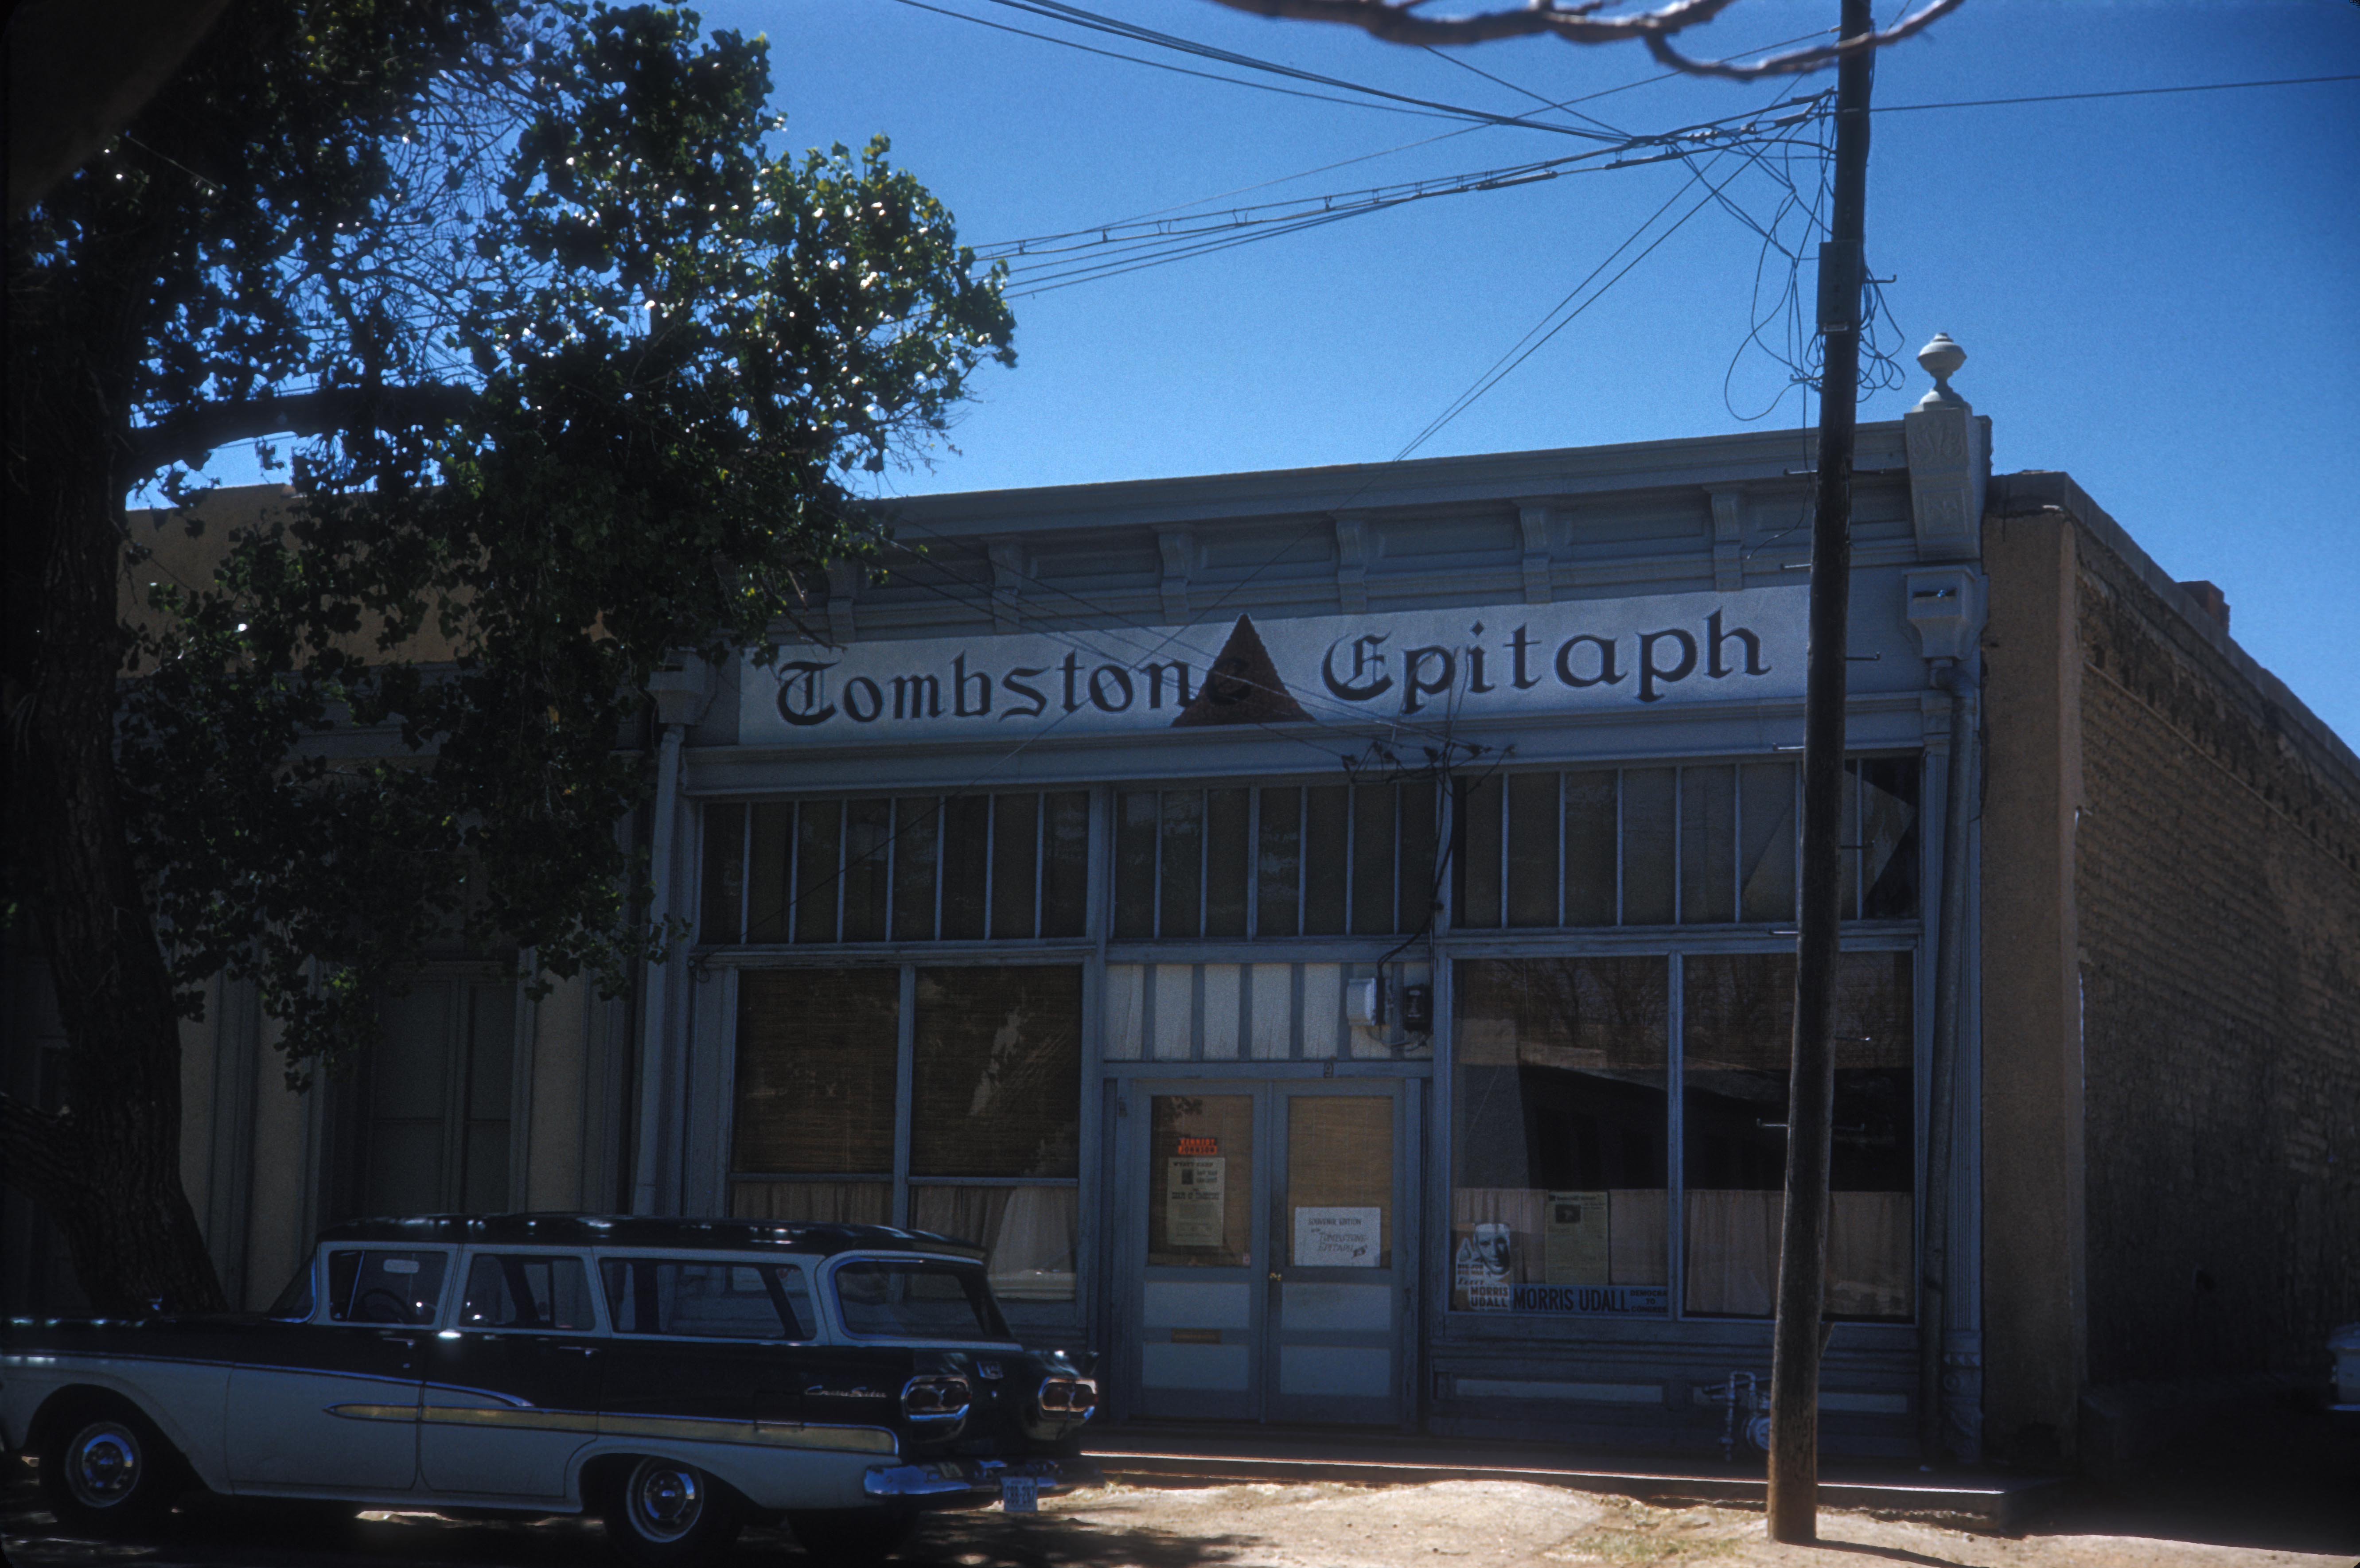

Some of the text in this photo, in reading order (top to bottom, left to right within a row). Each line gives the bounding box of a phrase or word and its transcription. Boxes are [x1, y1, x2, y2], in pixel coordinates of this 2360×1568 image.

[776, 605, 1772, 726] Tombstone Epitaph
[1471, 1287, 1508, 1296] MORRIS
[1513, 1288, 1630, 1312] MORRIS UDALL
[1471, 1297, 1507, 1307] UDALL
